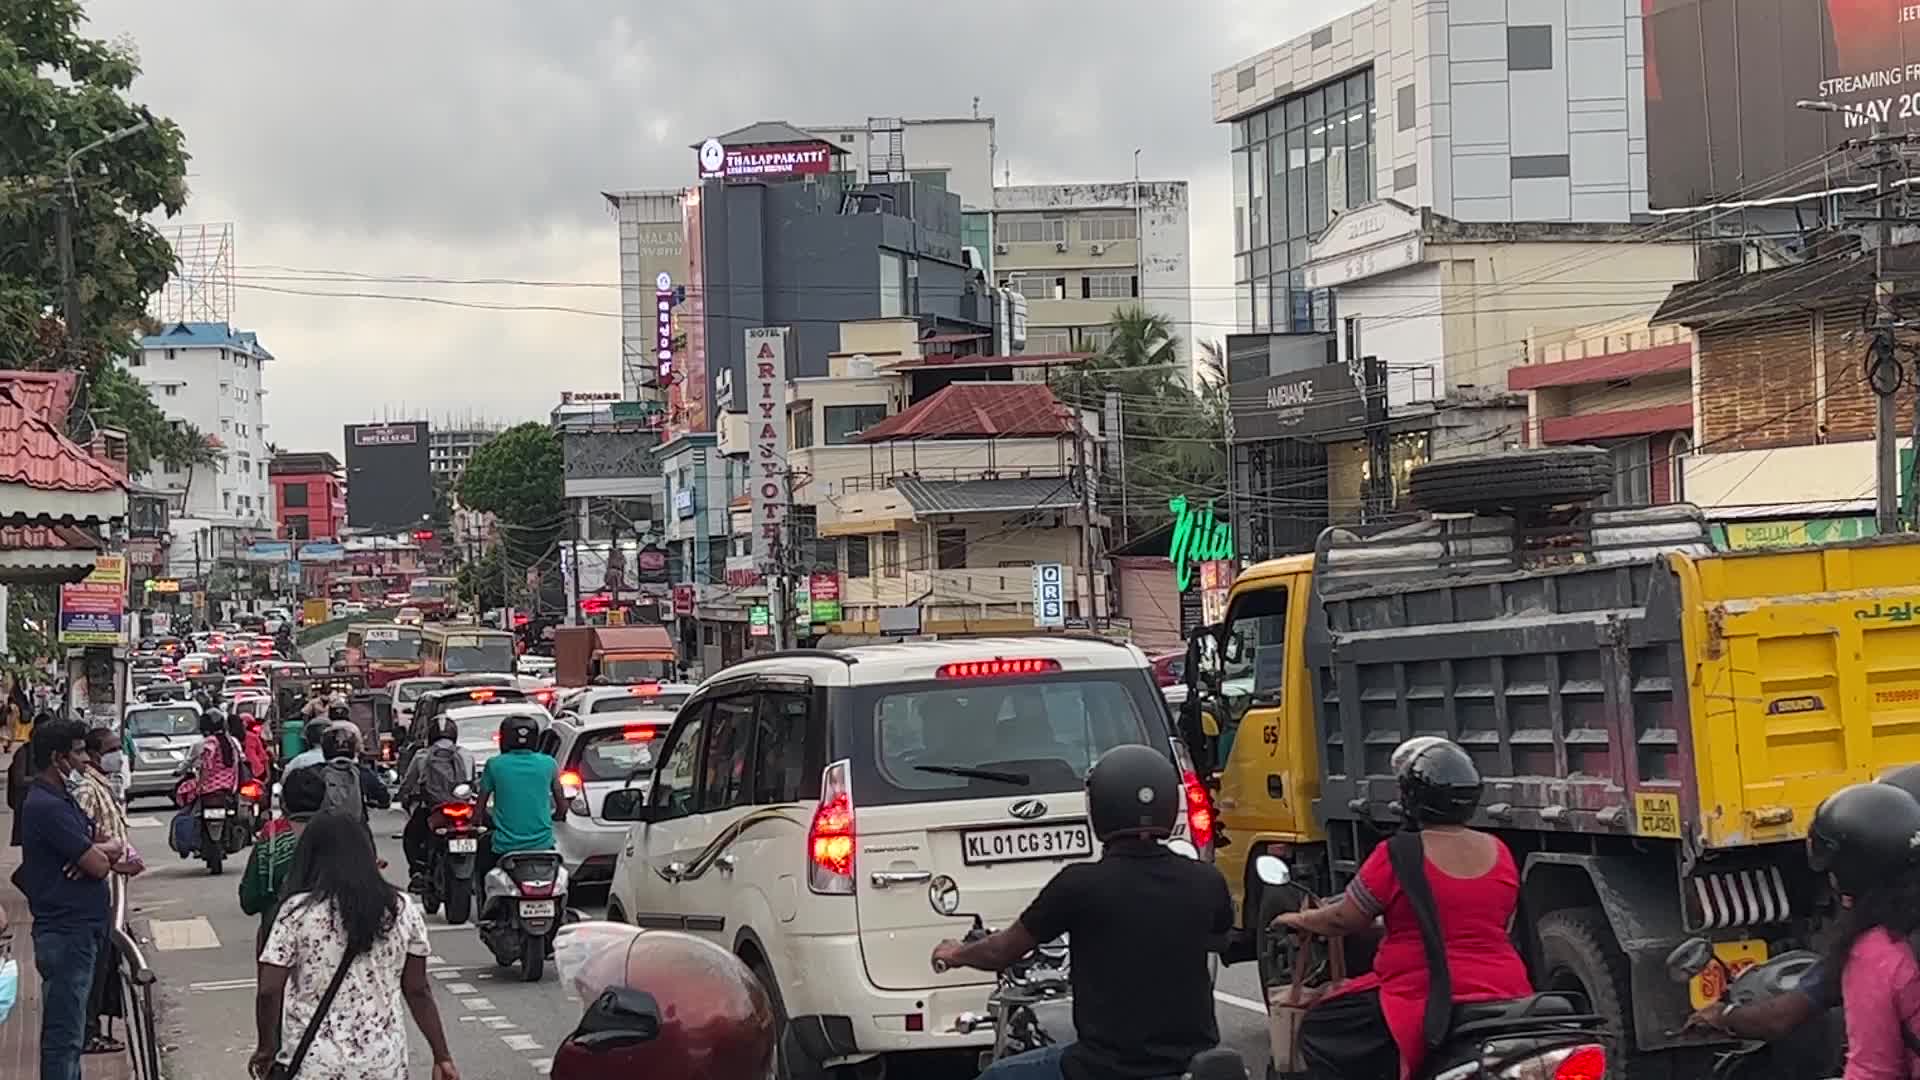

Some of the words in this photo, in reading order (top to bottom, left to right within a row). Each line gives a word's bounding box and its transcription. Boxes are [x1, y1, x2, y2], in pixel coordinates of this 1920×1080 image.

[1819, 67, 1901, 97] STREAMING
[1844, 98, 1893, 129] MAY
[726, 151, 822, 167] THALAPPAKATTI
[750, 328, 780, 338] HOTEL
[1267, 380, 1313, 408] AMBIANCE
[1043, 567, 1060, 616] QRS
